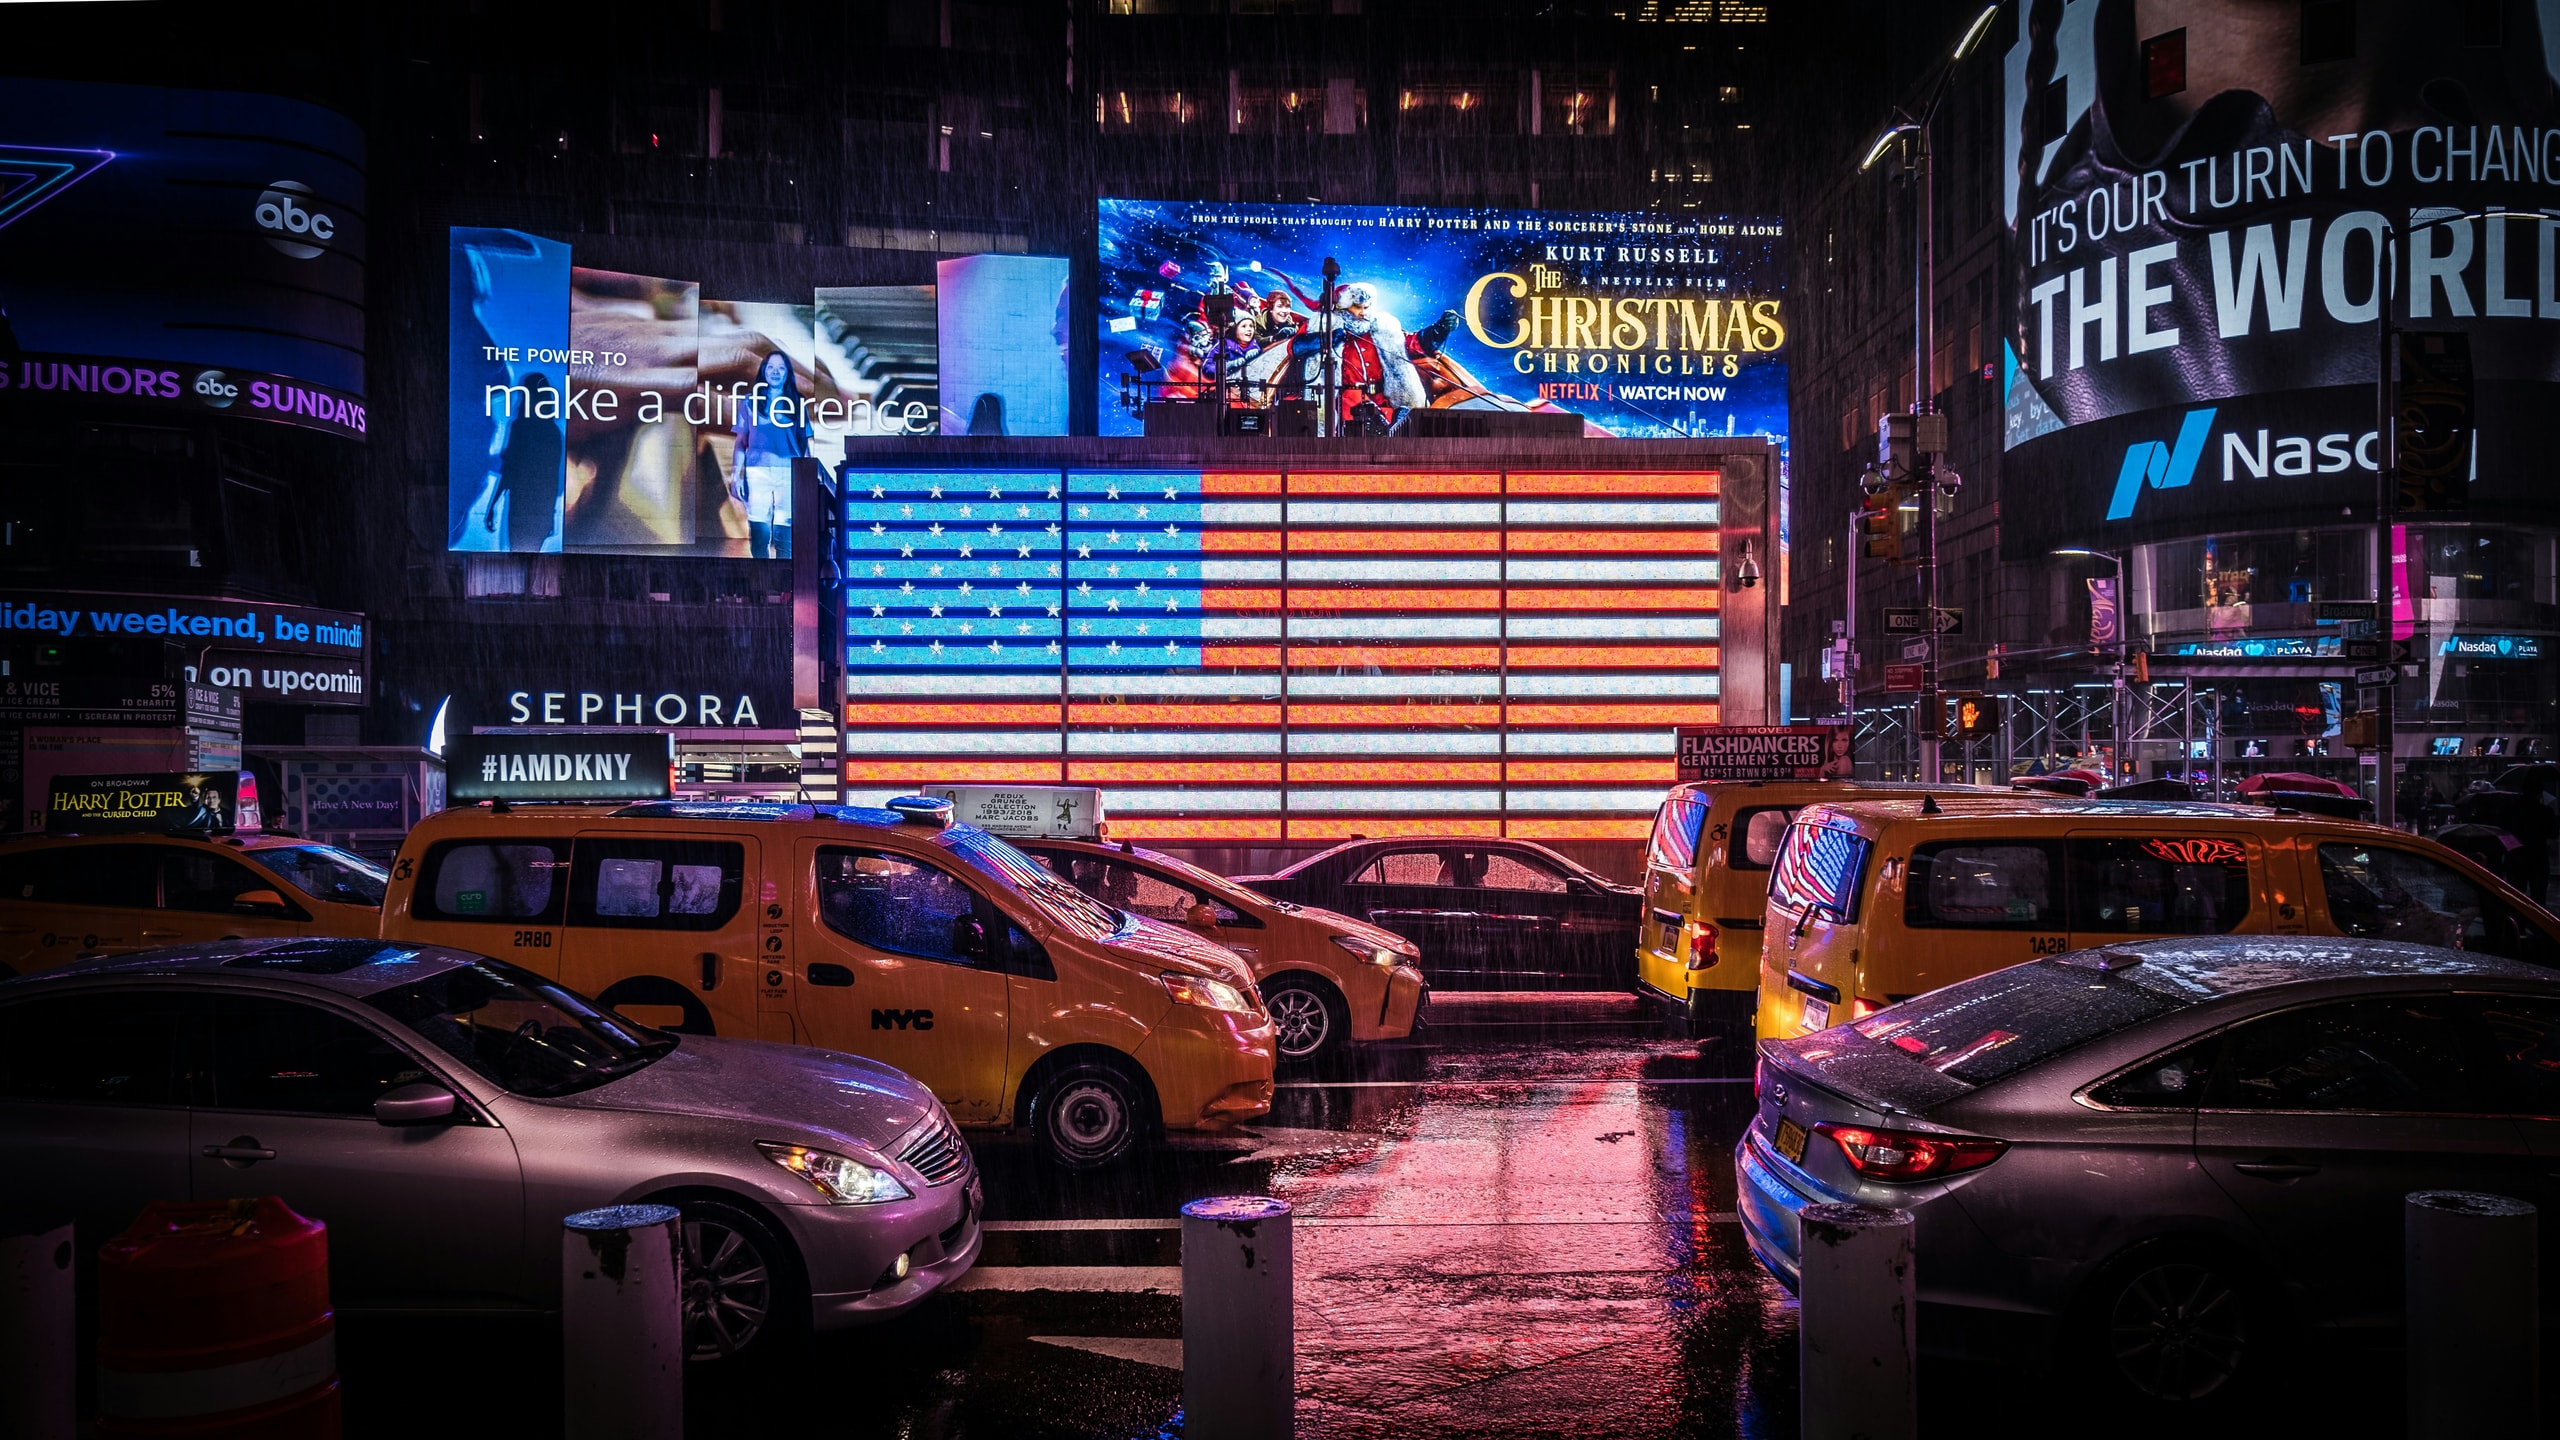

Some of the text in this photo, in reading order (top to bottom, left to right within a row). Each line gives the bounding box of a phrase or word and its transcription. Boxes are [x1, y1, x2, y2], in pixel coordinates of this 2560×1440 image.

[2030, 201, 2077, 268] IT'S
[2087, 170, 2169, 242] OUR
[2180, 138, 2312, 215] TURN
[2329, 130, 2393, 191] TO
[255, 197, 334, 239] abc
[1193, 215, 1218, 223] FROM
[1244, 217, 1278, 225] PEOPLE
[1282, 217, 1306, 225] THAT
[1310, 218, 1352, 226] BROUGHT
[1379, 217, 1421, 228] HARRY
[1428, 219, 1478, 230] POTTER
[1484, 220, 1510, 230] AND
[1517, 221, 1541, 231] THE
[1548, 222, 1626, 233] SORCERER'S
[1632, 223, 1672, 233] STONE
[1700, 225, 1735, 235] HOME
[1741, 226, 1783, 236] ALONE
[1546, 246, 1719, 264] KURT RUSSELL
[1581, 276, 1727, 287] A NETFLIX FILM
[1464, 272, 1786, 352] CHRISTMAS
[2031, 241, 2180, 381] THE
[482, 346, 628, 367] THE POWER TO
[1513, 350, 1739, 378] CHRONICLES
[18, 361, 181, 398] JUNIORS
[195, 378, 239, 398] abc
[250, 381, 366, 433] SUNDAYS
[1539, 383, 1727, 401] NETFLIX WATCH NOW
[484, 375, 929, 433] make a difference
[2322, 605, 2373, 619] Broadway
[89, 608, 265, 644] weekend,
[274, 615, 310, 642] be
[1895, 617, 1951, 627] ONE AY
[2360, 622, 2369, 635] 43
[2197, 646, 2313, 657] Nasdaq PLAYA
[2355, 646, 2374, 656] ONE
[2459, 641, 2497, 655] Nasdaq
[211, 666, 251, 688] on
[262, 669, 362, 694] upcomin
[2360, 674, 2373, 682] ONE
[6, 682, 60, 696] & VICE
[151, 684, 176, 698] 5%
[8, 698, 24, 706] ICE
[27, 697, 60, 706] CREAM
[121, 699, 176, 707] TO CHARITY
[510, 692, 759, 725] SEPHORA
[9, 711, 24, 719] ICE
[26, 711, 60, 719] CREAM!
[85, 713, 120, 721] SCREAM
[123, 713, 132, 721] IN
[135, 713, 176, 721] PROTEST!
[1703, 727, 1793, 735] WE'VE MOVED
[29, 736, 102, 744] A WOMAN'S PLACE
[1681, 735, 1821, 755] FLASHDANCERS
[1681, 753, 1820, 767] GENTLEMEN'S CLUB
[482, 754, 631, 782] #IAMDKNY
[1736, 768, 1760, 778] BTWN
[91, 779, 150, 788] ON BROADWAY
[53, 790, 189, 811] HARRY POTTER
[312, 800, 399, 811] Have A New Day!
[102, 810, 132, 819] CURSED
[133, 810, 158, 818] CHILD
[514, 931, 552, 947] 2R80
[2029, 937, 2066, 955] 1A28
[872, 1009, 934, 1030] NYC
